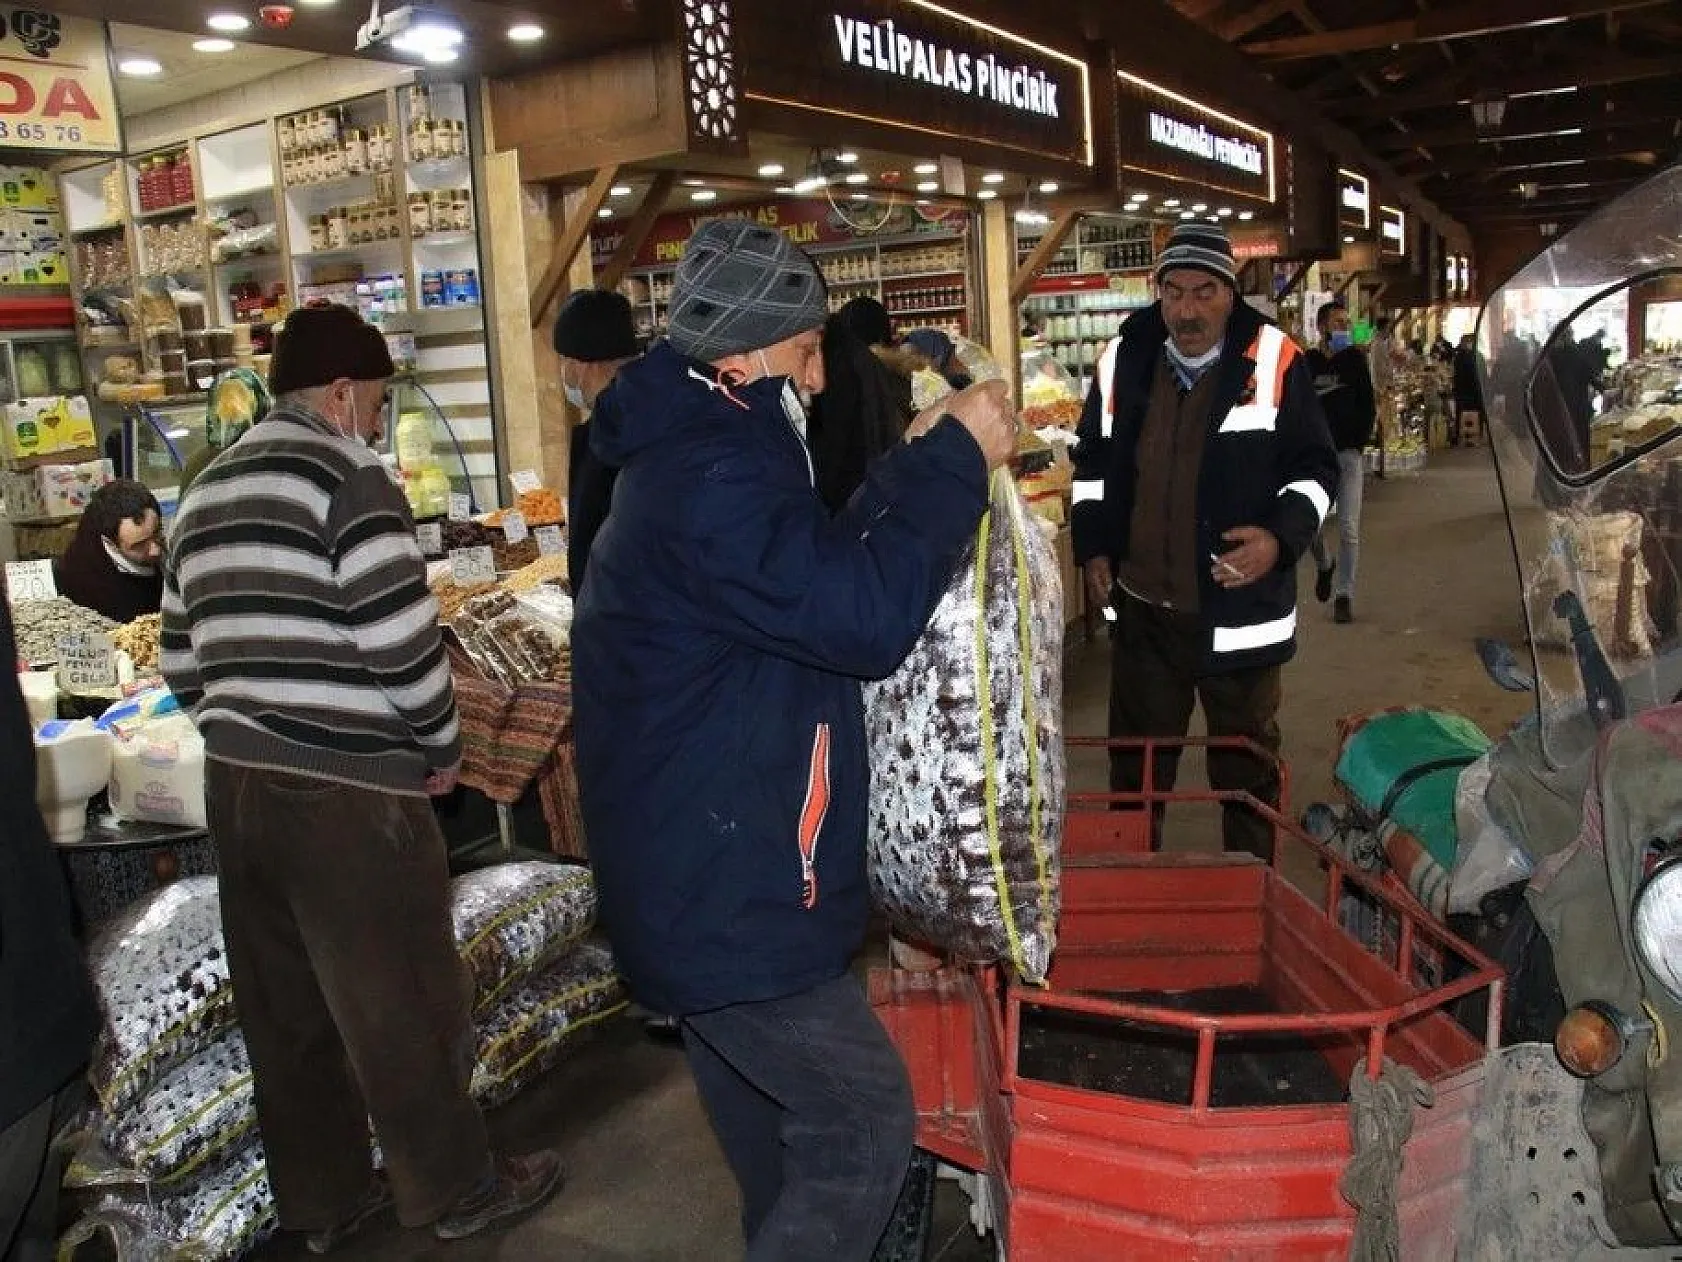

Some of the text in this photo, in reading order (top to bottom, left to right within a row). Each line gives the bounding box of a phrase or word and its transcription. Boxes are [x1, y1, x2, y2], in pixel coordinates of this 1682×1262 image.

[834, 14, 1059, 119] VELİPALAS PİNCİRİK
[17, 122, 46, 141] 65
[54, 125, 82, 143] 76
